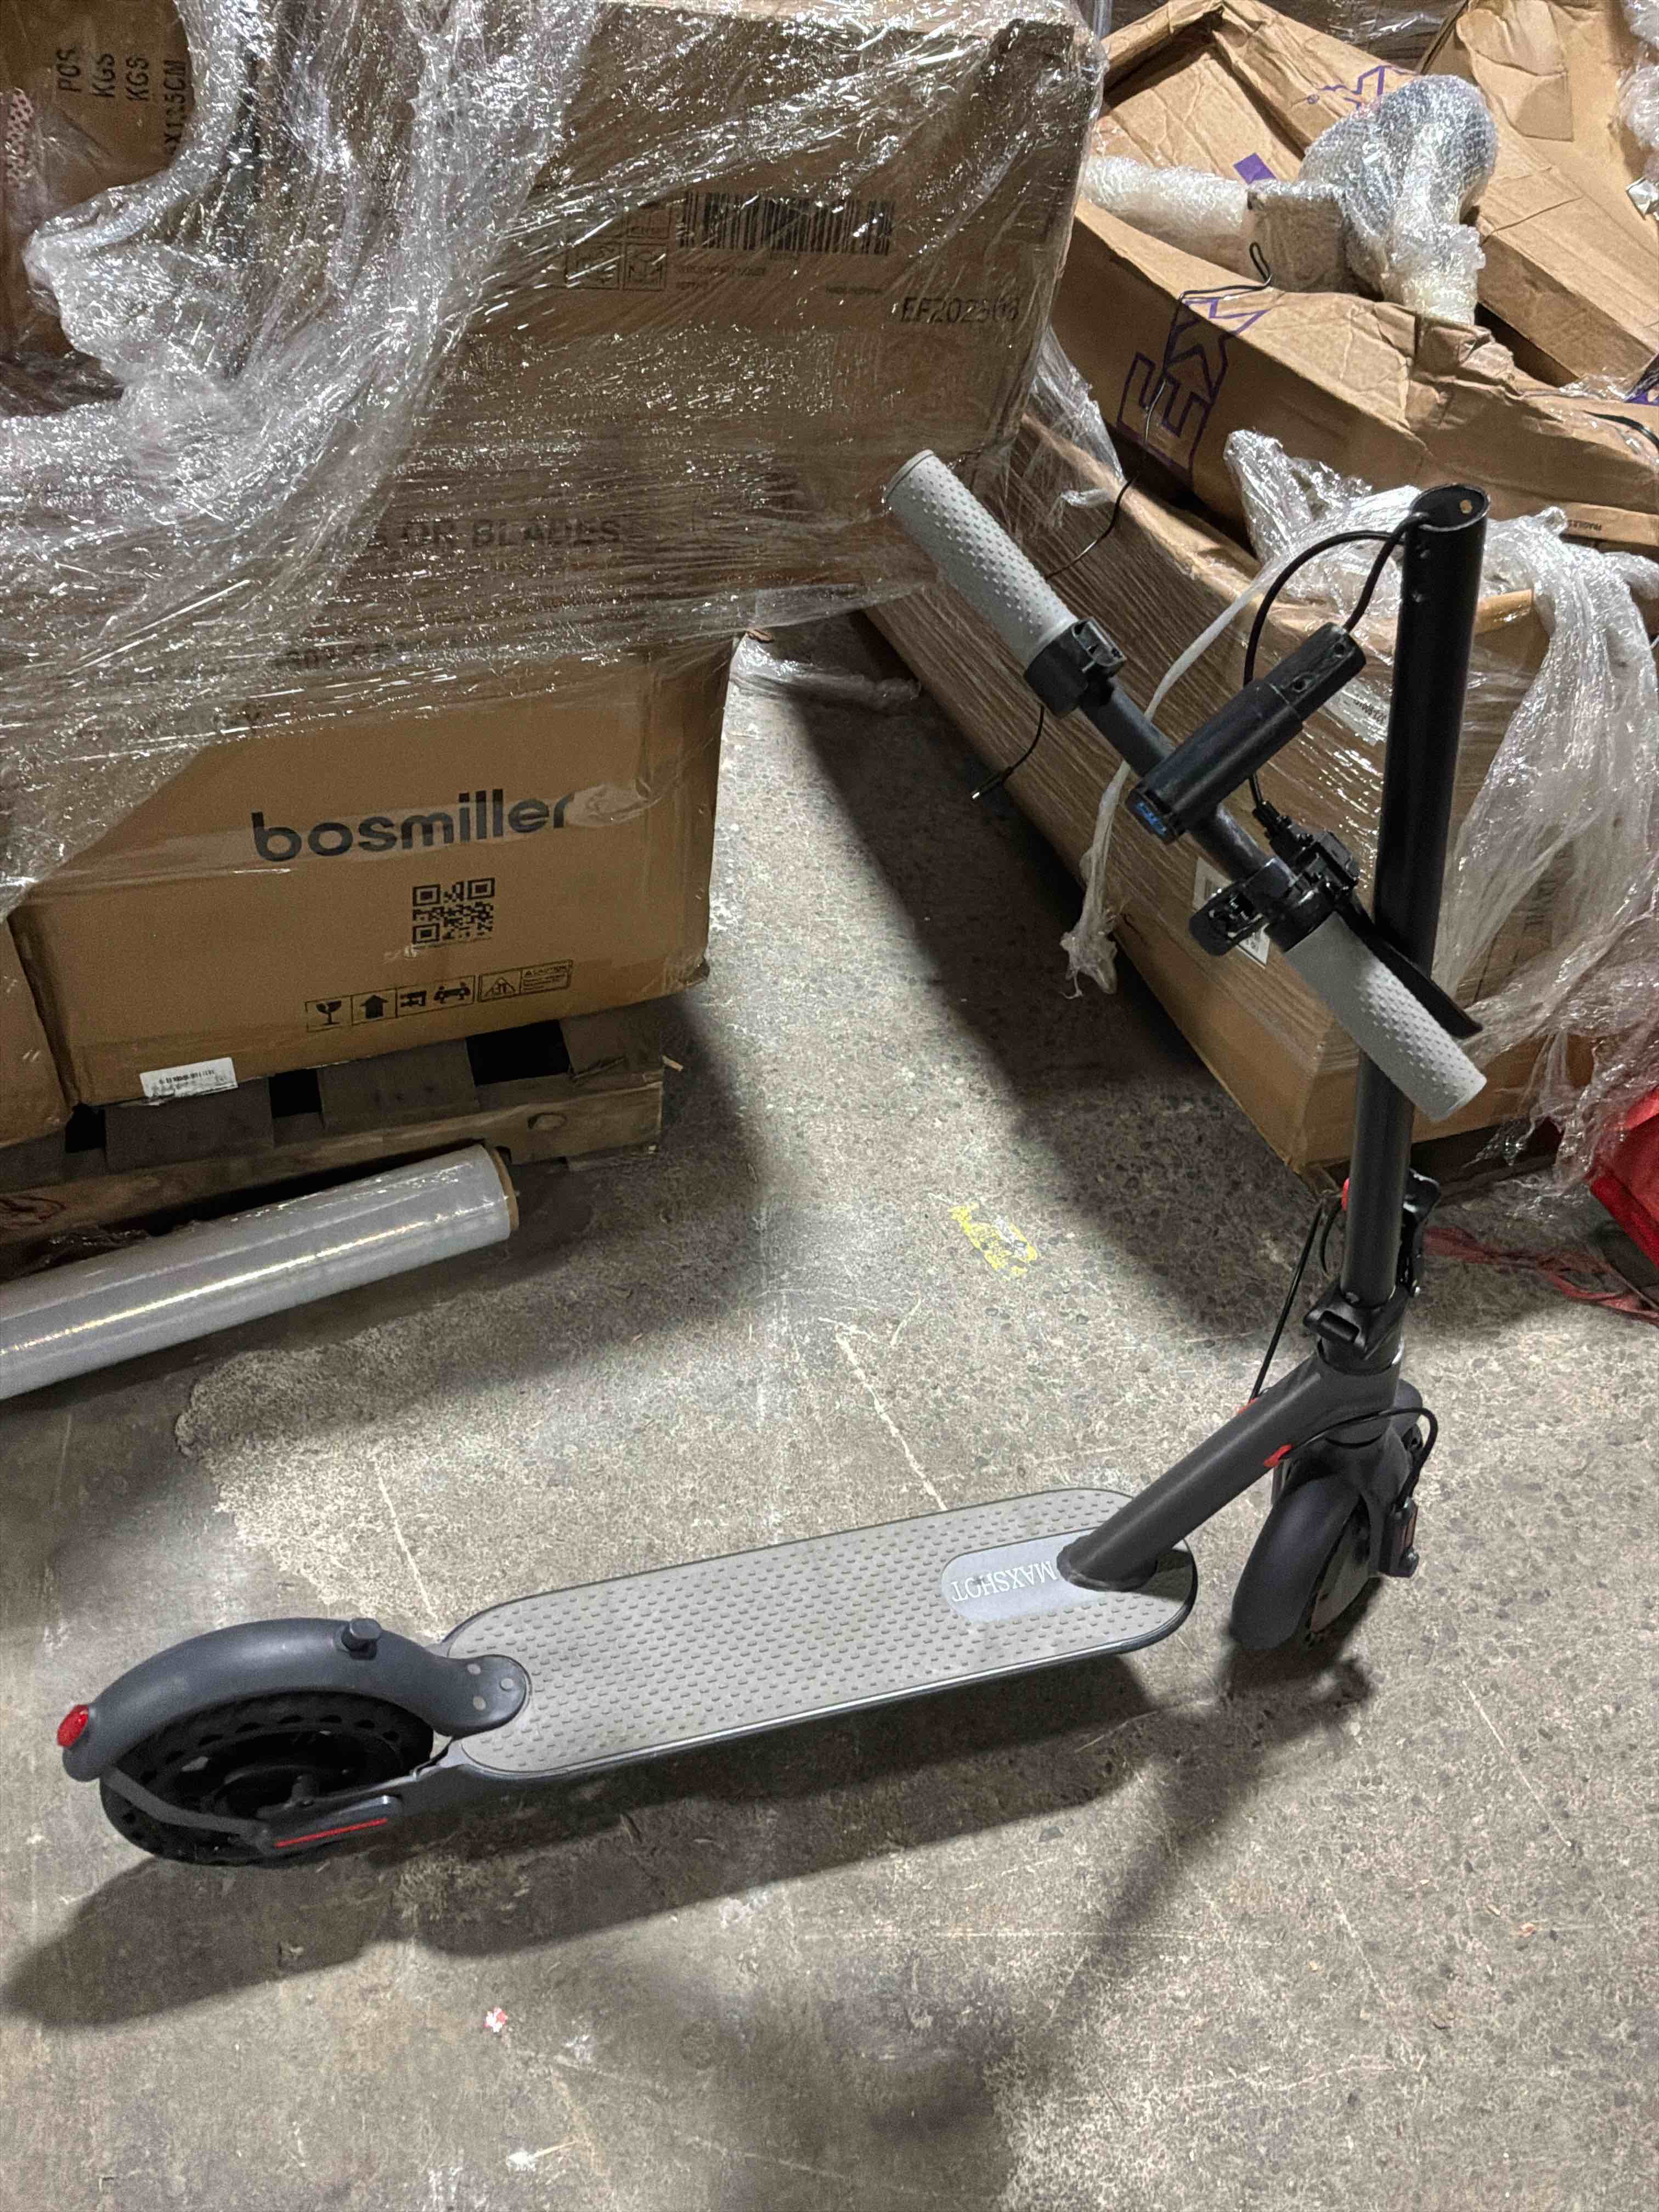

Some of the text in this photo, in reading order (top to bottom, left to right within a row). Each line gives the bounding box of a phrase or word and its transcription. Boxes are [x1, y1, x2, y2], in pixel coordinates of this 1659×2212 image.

[90, 53, 115, 97] KGS
[125, 56, 149, 101] KGS
[251, 788, 575, 862] bosmiller
[950, 1560, 1058, 1602] MAXSHOT
